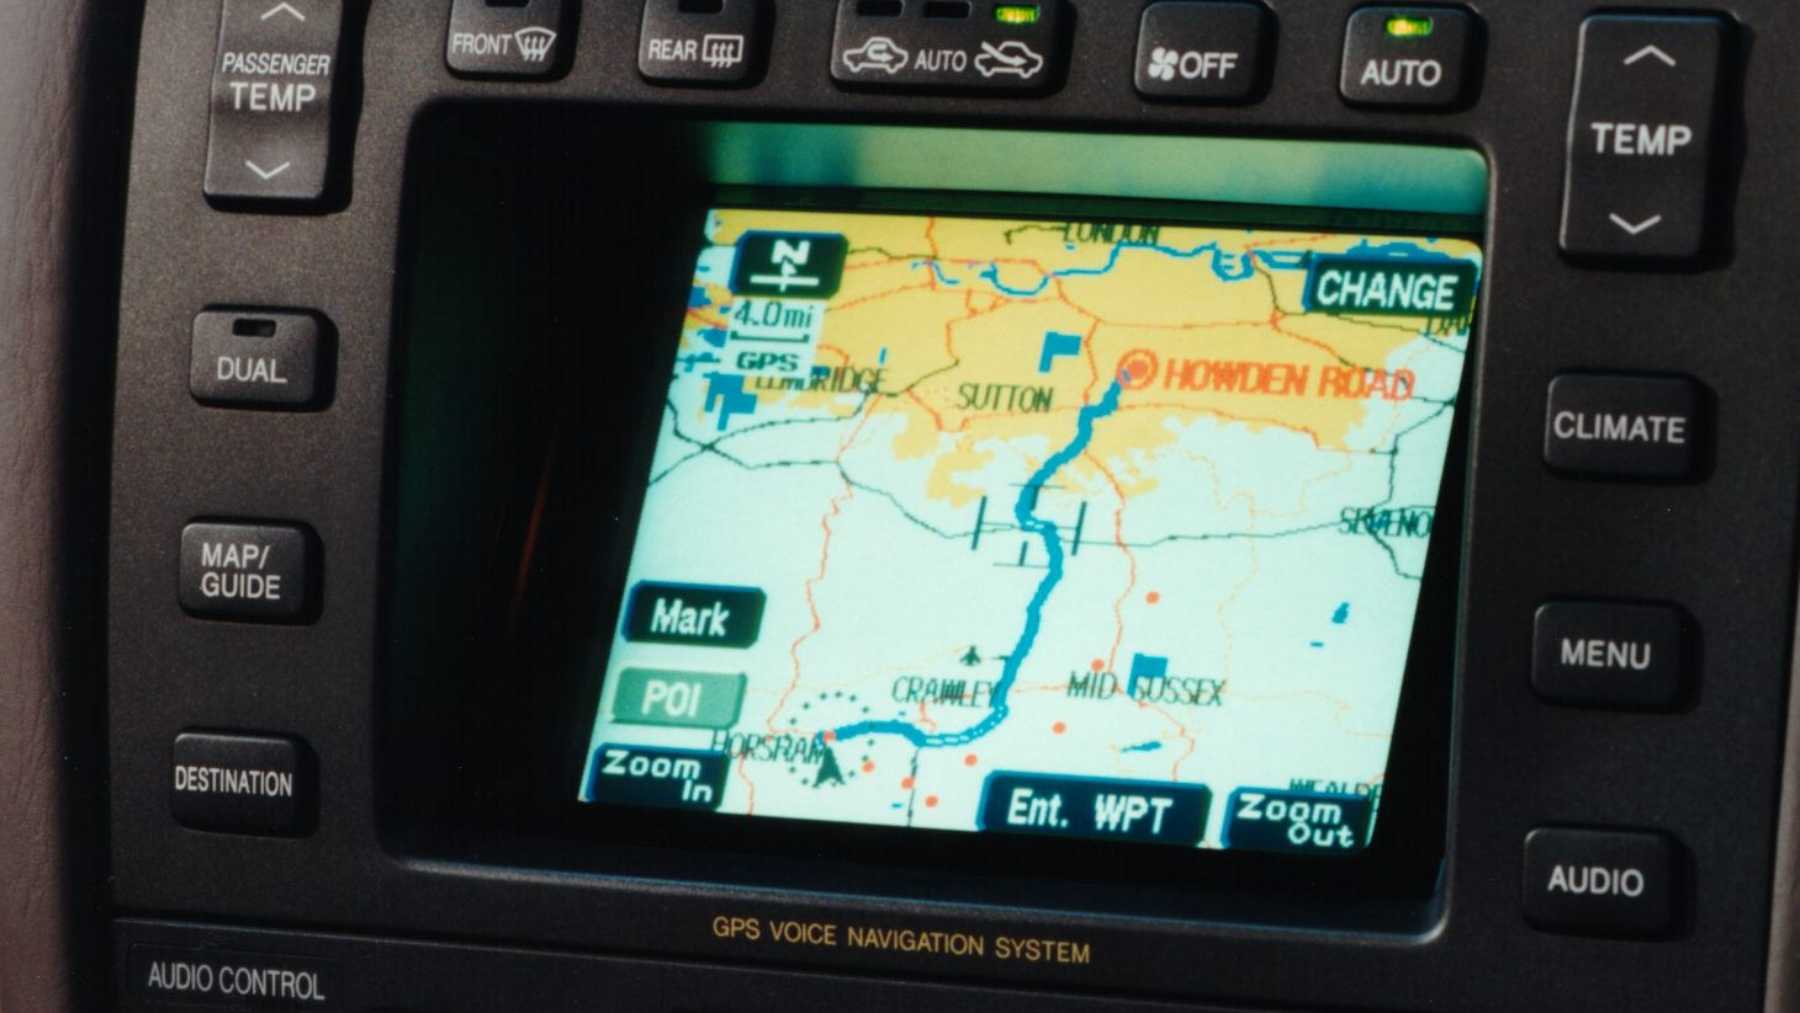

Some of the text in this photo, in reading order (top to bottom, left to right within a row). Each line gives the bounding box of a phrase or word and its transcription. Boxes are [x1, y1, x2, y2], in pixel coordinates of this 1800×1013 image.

[452, 33, 512, 56] FRONT
[648, 39, 697, 61] REAR
[222, 53, 331, 76] PASSENGER
[914, 50, 967, 72] AUTO
[1180, 51, 1239, 79] OFF
[1361, 60, 1442, 87] AUTO
[230, 82, 316, 112] TEMP
[1591, 122, 1692, 155] TEMP
[770, 239, 811, 265] N
[1316, 269, 1459, 311] CHANGE
[733, 300, 815, 329] 4.0mi
[217, 356, 288, 383] DUAL
[736, 351, 801, 371] GPS
[1163, 358, 1416, 402] HOWDEN ROAD
[957, 382, 1054, 415] SUTTON
[1553, 411, 1687, 444] CLIMATE
[201, 543, 270, 570] MAP/
[201, 571, 281, 600] GUIDE
[650, 598, 730, 638] Mark
[1560, 638, 1651, 671] MENU
[641, 679, 703, 719] POI
[891, 675, 1001, 709] CRAWLEY
[1066, 671, 1226, 707] MID SUSSEX
[602, 749, 702, 780] Zoom
[174, 765, 293, 797] DESTINATION
[681, 780, 714, 803] In
[1005, 787, 1173, 835] Ent. WPT
[1237, 792, 1342, 825] Zoom
[1287, 821, 1355, 849] Out
[1547, 865, 1644, 897] AUDIO
[712, 915, 1091, 965] GPS VOICE NAVIGATION SYSTEM
[148, 961, 326, 1001] AUDIO CONTROL
